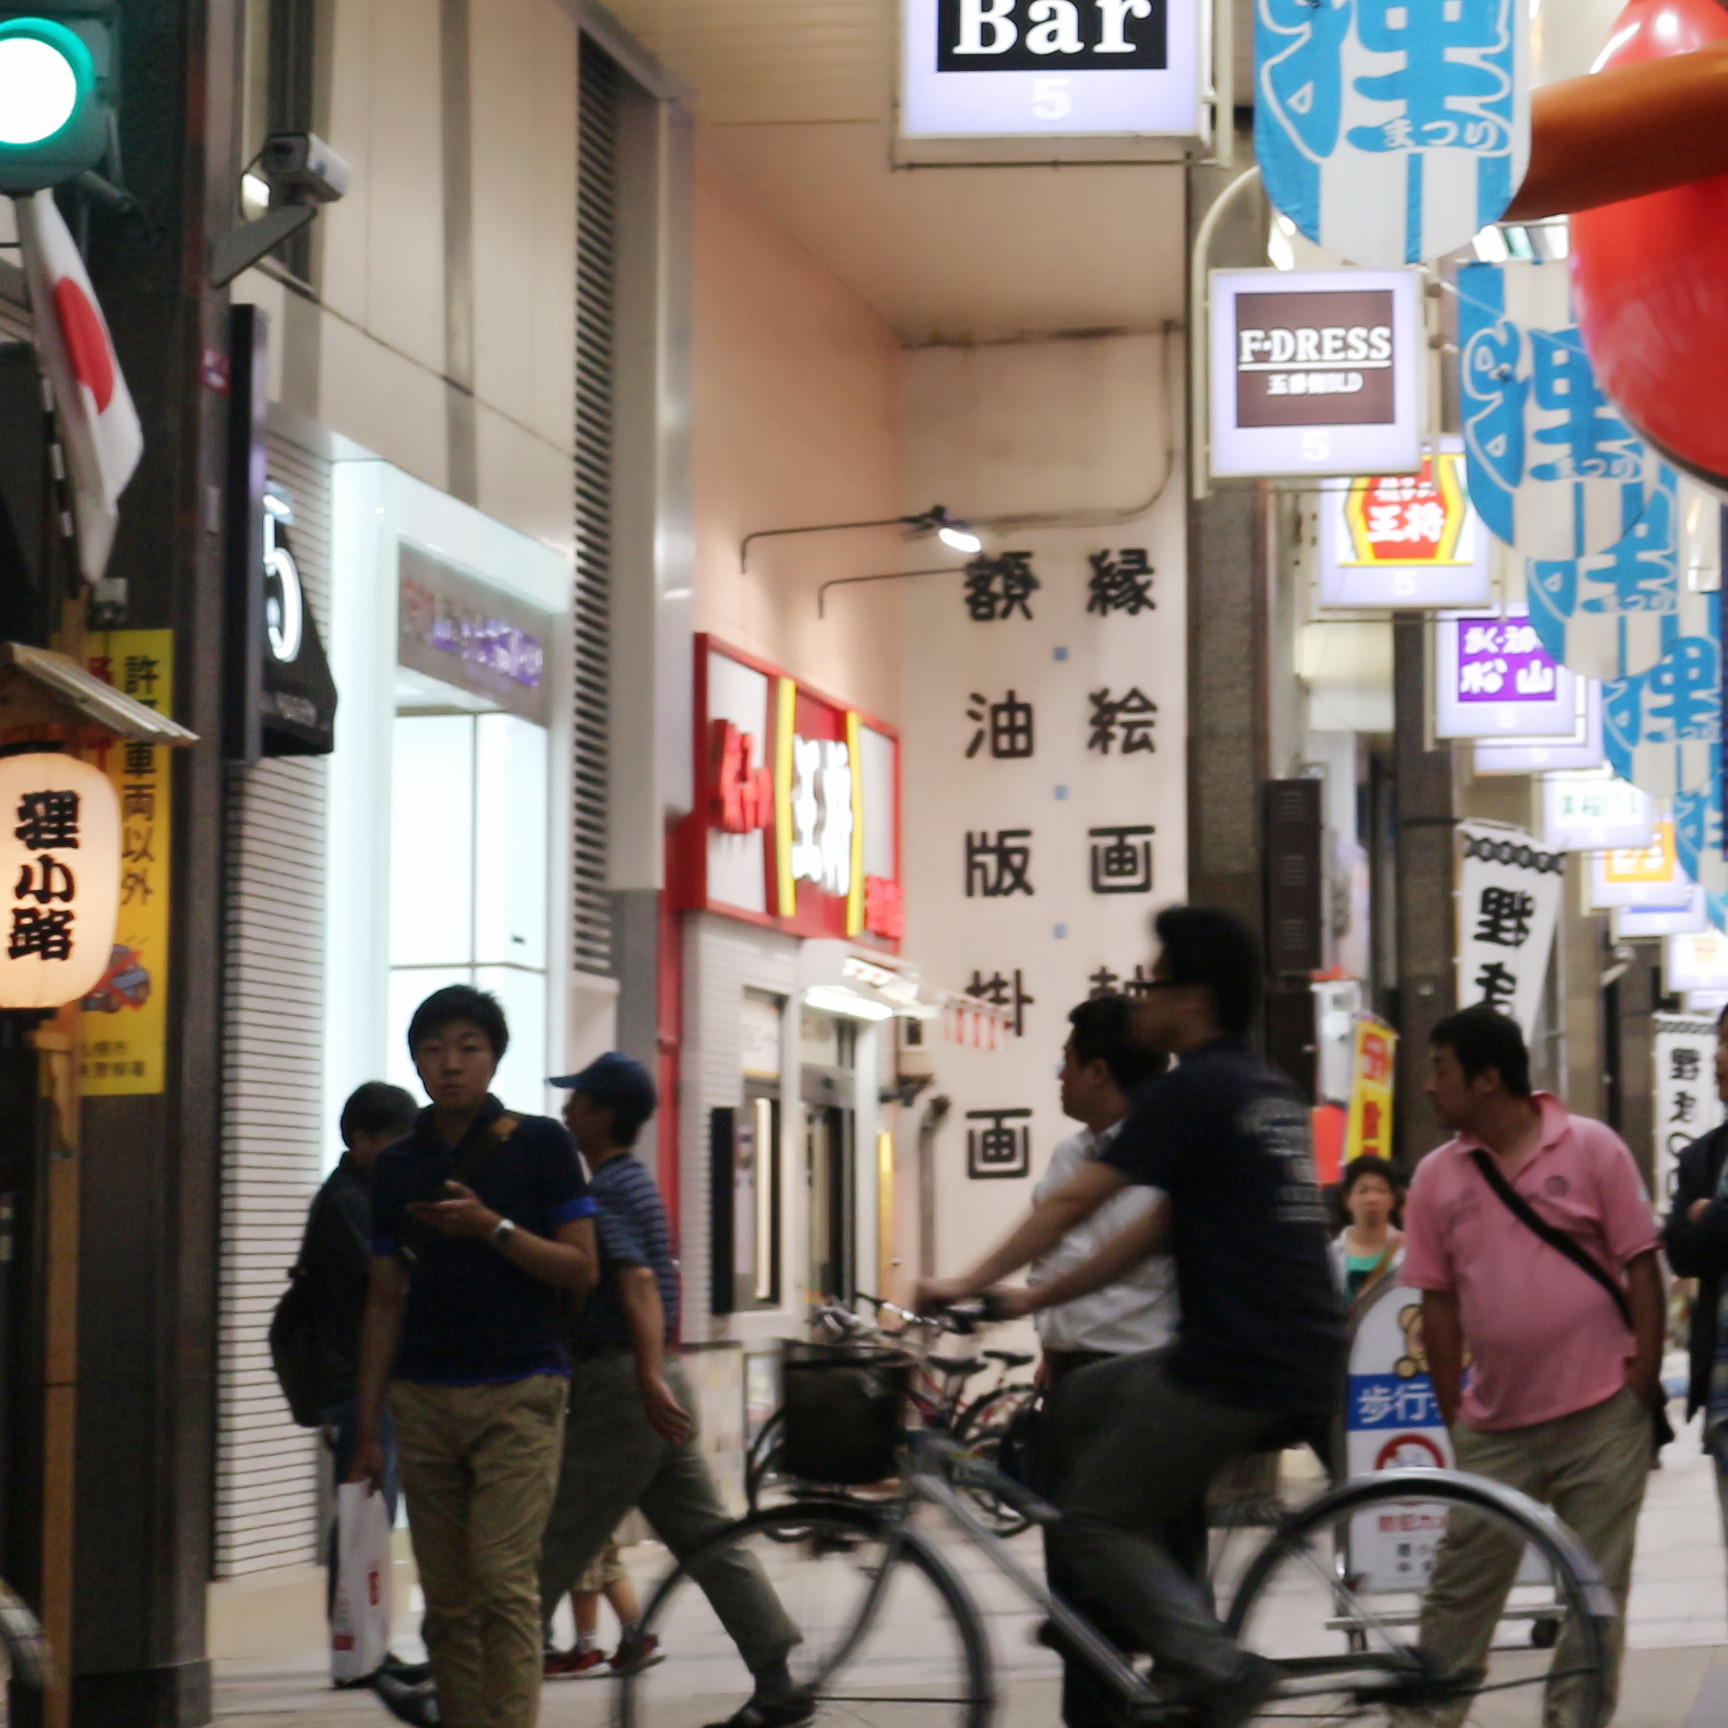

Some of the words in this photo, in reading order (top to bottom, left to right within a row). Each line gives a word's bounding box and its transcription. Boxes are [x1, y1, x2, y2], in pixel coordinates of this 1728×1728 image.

[1031, 79, 1071, 120] 5
[1302, 432, 1330, 461] 5
[122, 655, 160, 906] 許車両以外
[8, 789, 81, 962] 狸小路
[1358, 1383, 1440, 1423] 歩行
